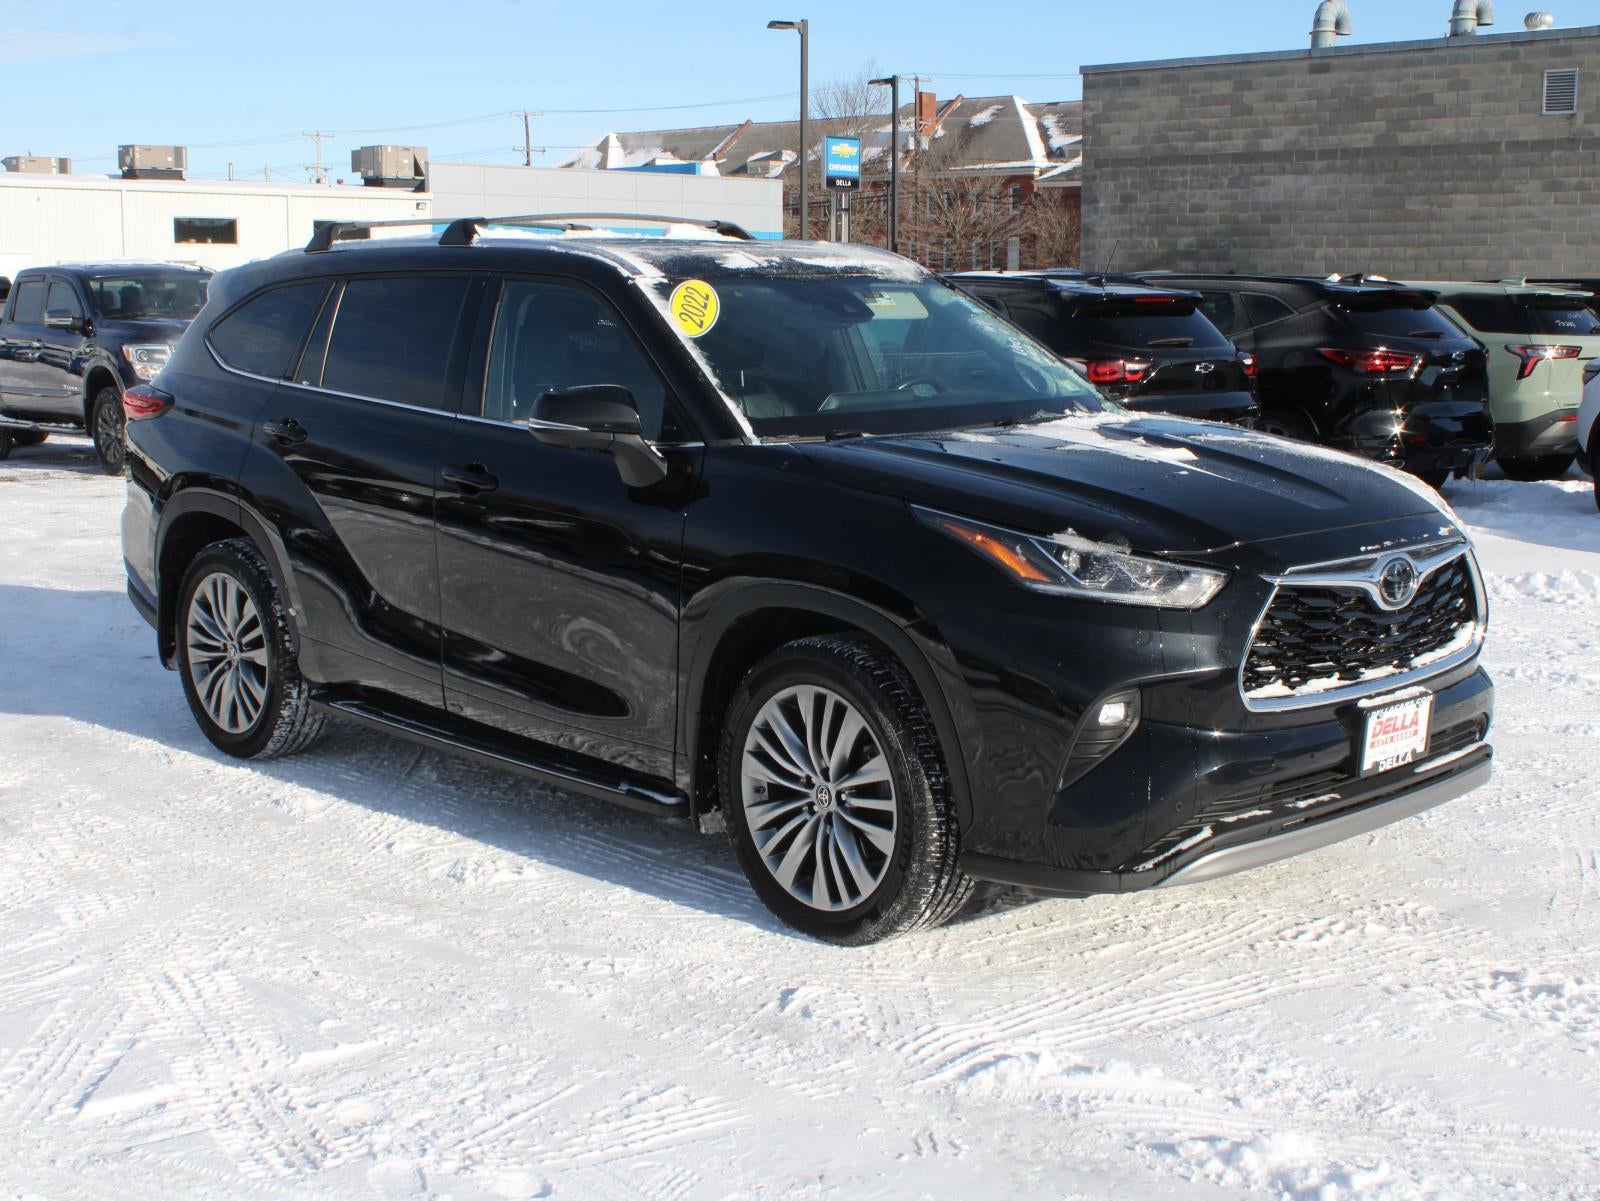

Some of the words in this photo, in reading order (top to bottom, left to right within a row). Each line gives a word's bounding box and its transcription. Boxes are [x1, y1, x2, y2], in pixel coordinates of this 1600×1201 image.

[828, 163, 859, 172] CHEVROLET
[835, 179, 852, 187] DELLA
[678, 286, 710, 330] 2022
[1371, 710, 1419, 739] DELLA
[1378, 751, 1412, 772] DELLA
